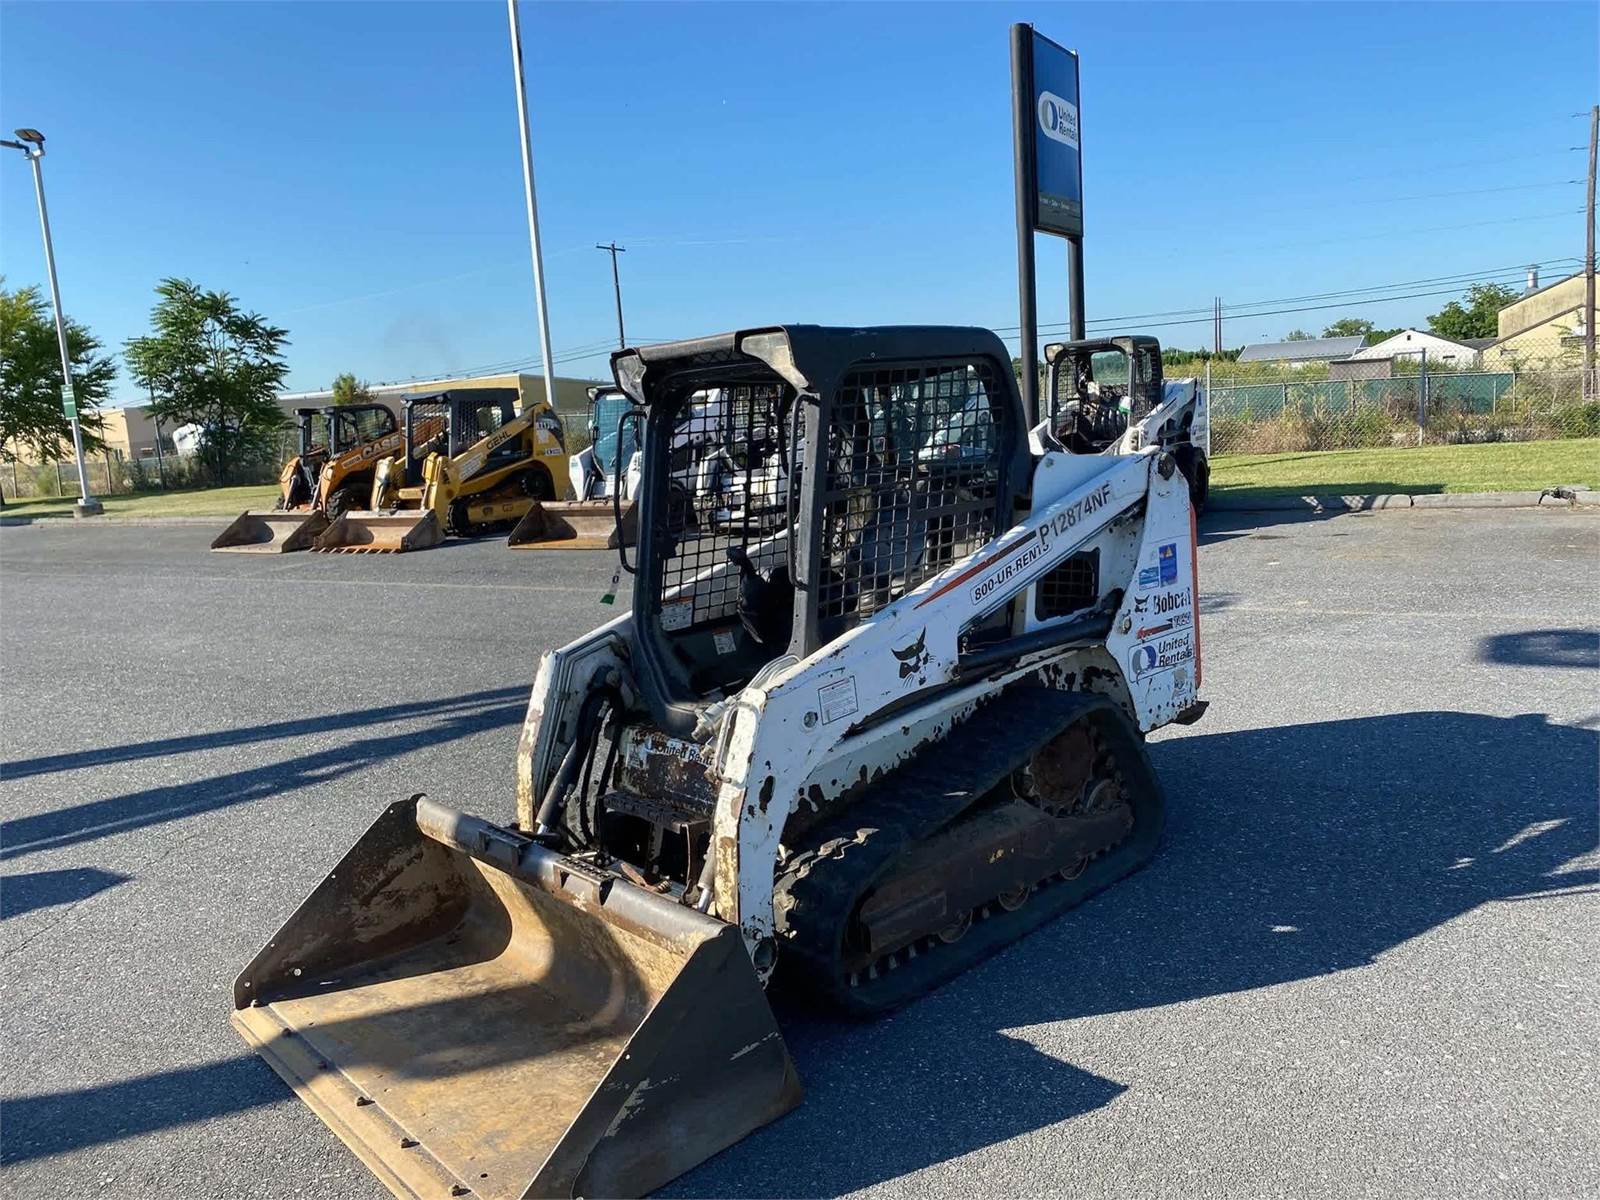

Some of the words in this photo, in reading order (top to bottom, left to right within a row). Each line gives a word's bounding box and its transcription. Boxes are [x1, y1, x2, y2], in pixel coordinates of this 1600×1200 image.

[1058, 106, 1077, 127] United
[362, 434, 401, 458] CASE
[486, 431, 512, 449] GEHL
[1039, 485, 1112, 546] P12874NF
[1158, 633, 1190, 654] United
[1159, 645, 1193, 667] Rentals
